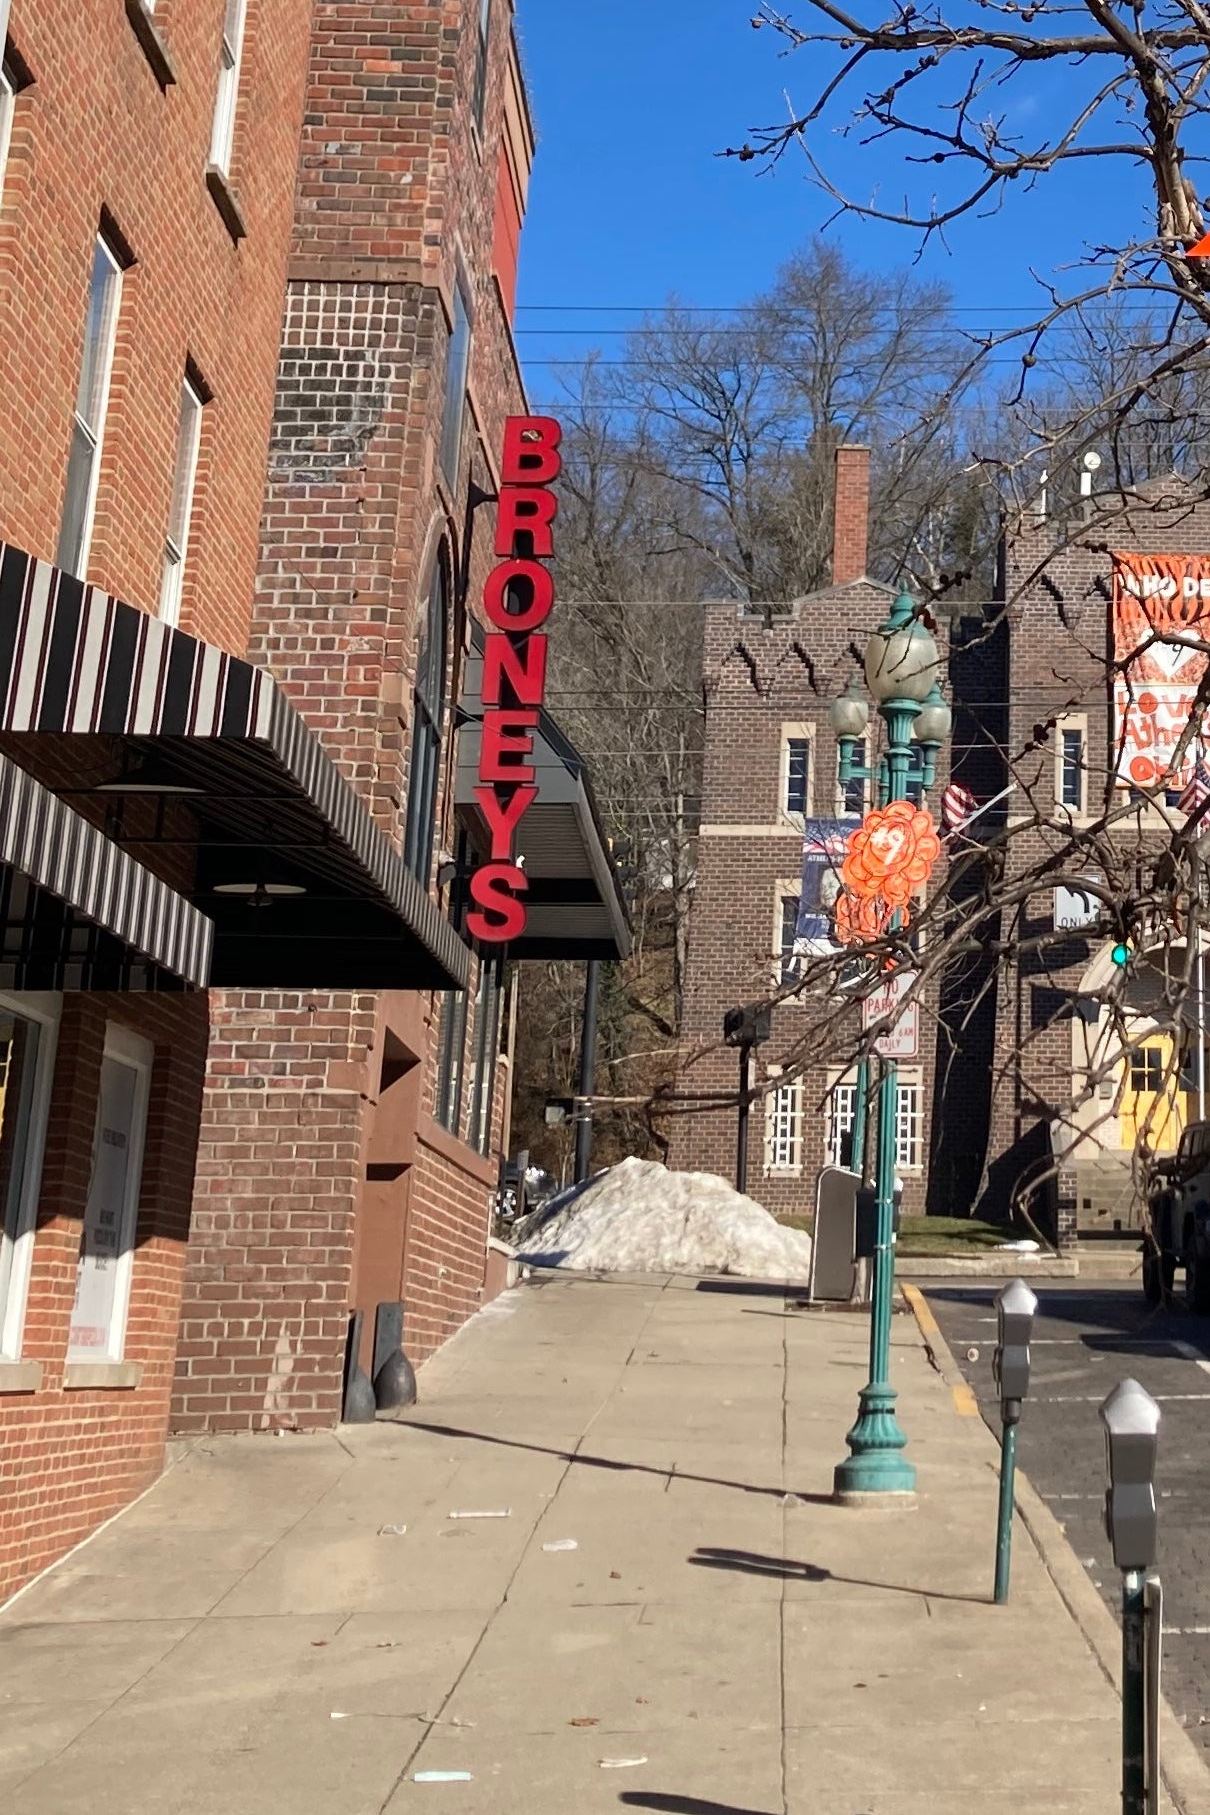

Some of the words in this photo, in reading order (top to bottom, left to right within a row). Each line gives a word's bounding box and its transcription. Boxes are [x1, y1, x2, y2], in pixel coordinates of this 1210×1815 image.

[466, 415, 563, 943] BRONEYS
[868, 997, 914, 1013] PARKG
[879, 1038, 902, 1050] DAILY
